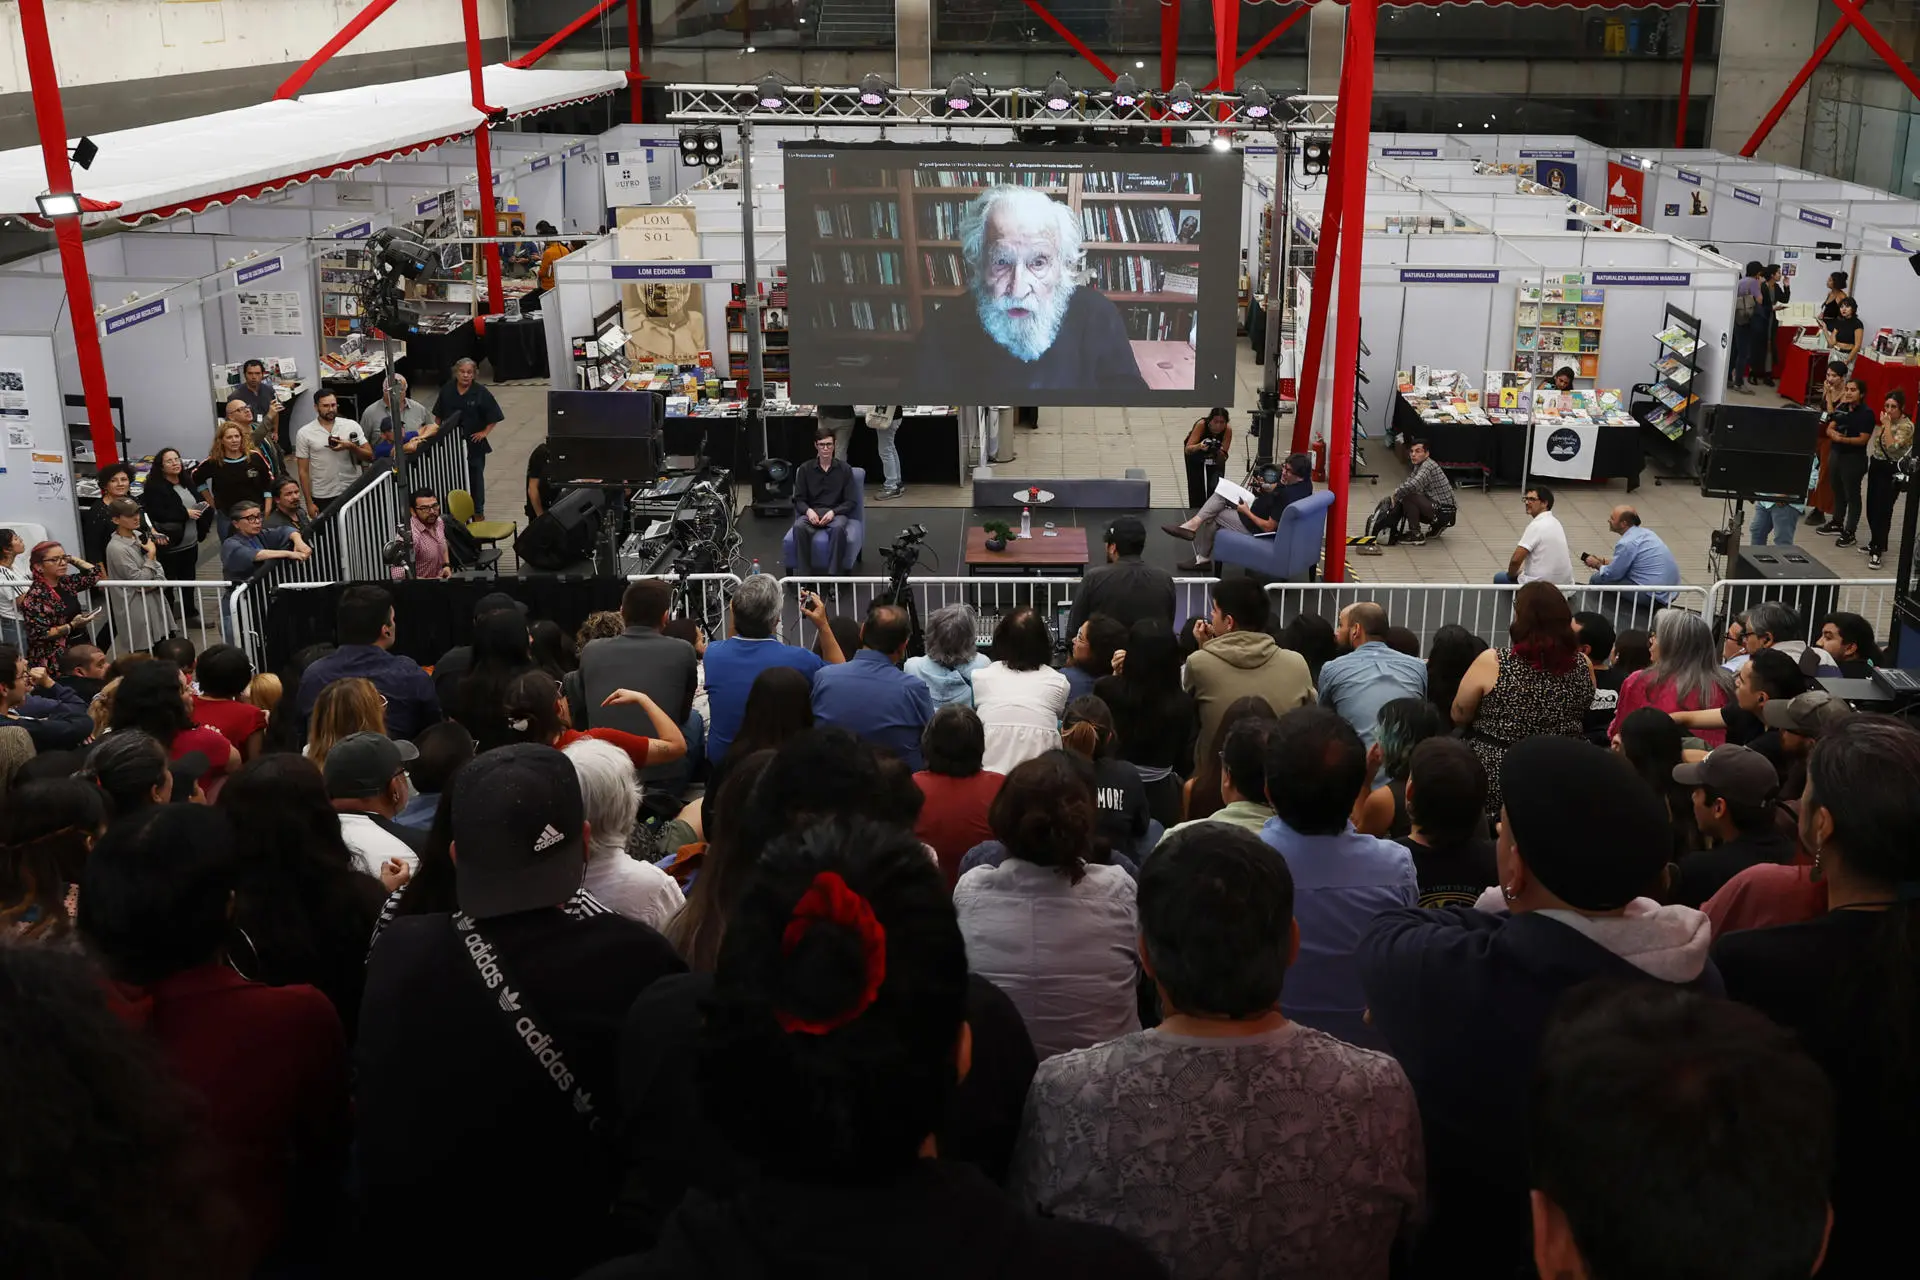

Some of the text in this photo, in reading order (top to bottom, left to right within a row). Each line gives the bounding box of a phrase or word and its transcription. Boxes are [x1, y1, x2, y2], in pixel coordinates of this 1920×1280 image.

[643, 215, 670, 225] LOM
[644, 232, 672, 241] SOL
[1097, 787, 1124, 811] MORE
[534, 832, 565, 852] adidas
[465, 933, 504, 989] adidas
[515, 1016, 575, 1092] adidas
